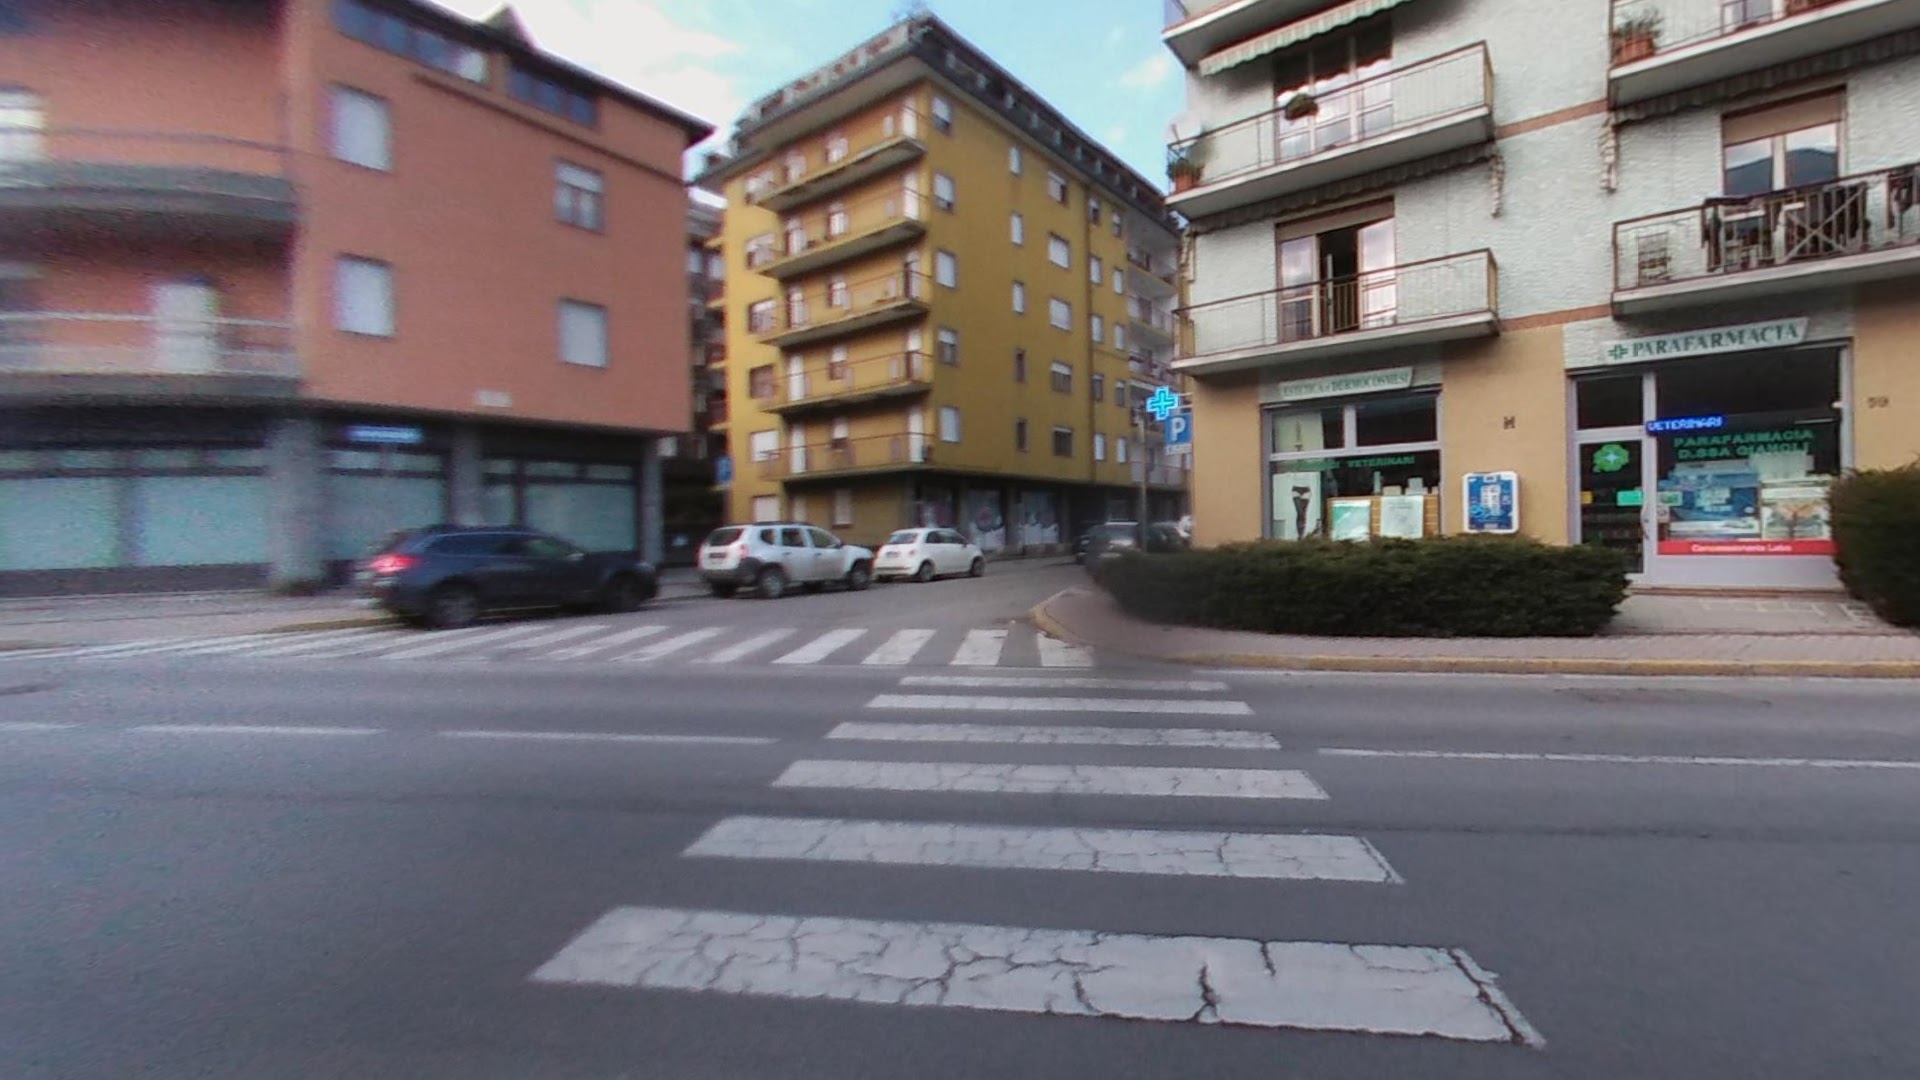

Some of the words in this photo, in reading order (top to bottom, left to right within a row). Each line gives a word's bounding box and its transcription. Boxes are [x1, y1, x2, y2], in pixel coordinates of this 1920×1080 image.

[1632, 322, 1798, 357] PARAFARMACIA
[1171, 417, 1186, 442] P
[1647, 415, 1723, 431] VETERINARI
[1674, 429, 1814, 448] PARAFARMACIA
